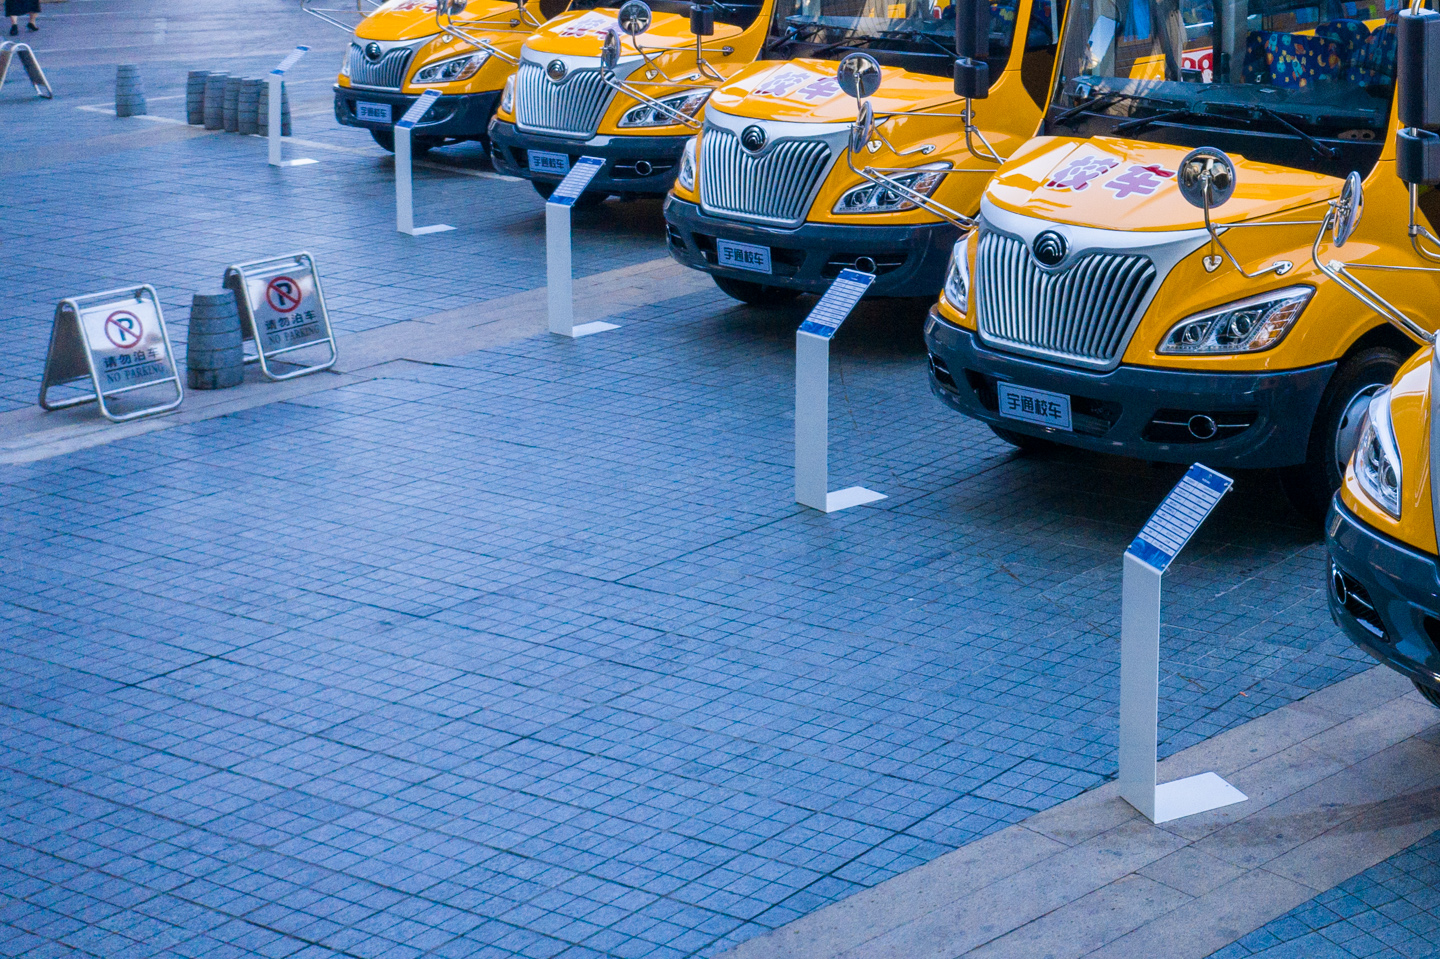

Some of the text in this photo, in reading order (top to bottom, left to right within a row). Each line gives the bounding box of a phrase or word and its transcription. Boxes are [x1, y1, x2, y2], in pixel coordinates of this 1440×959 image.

[752, 71, 841, 100] 校车
[1044, 155, 1177, 200] 校车
[723, 247, 764, 265] 宇通校车
[264, 310, 316, 330] 请勿泊车
[268, 324, 320, 345] NO PARKING
[103, 347, 159, 368] 请勿泊车
[106, 362, 164, 383] NO PARKING
[1006, 393, 1062, 419] 宇通校车
